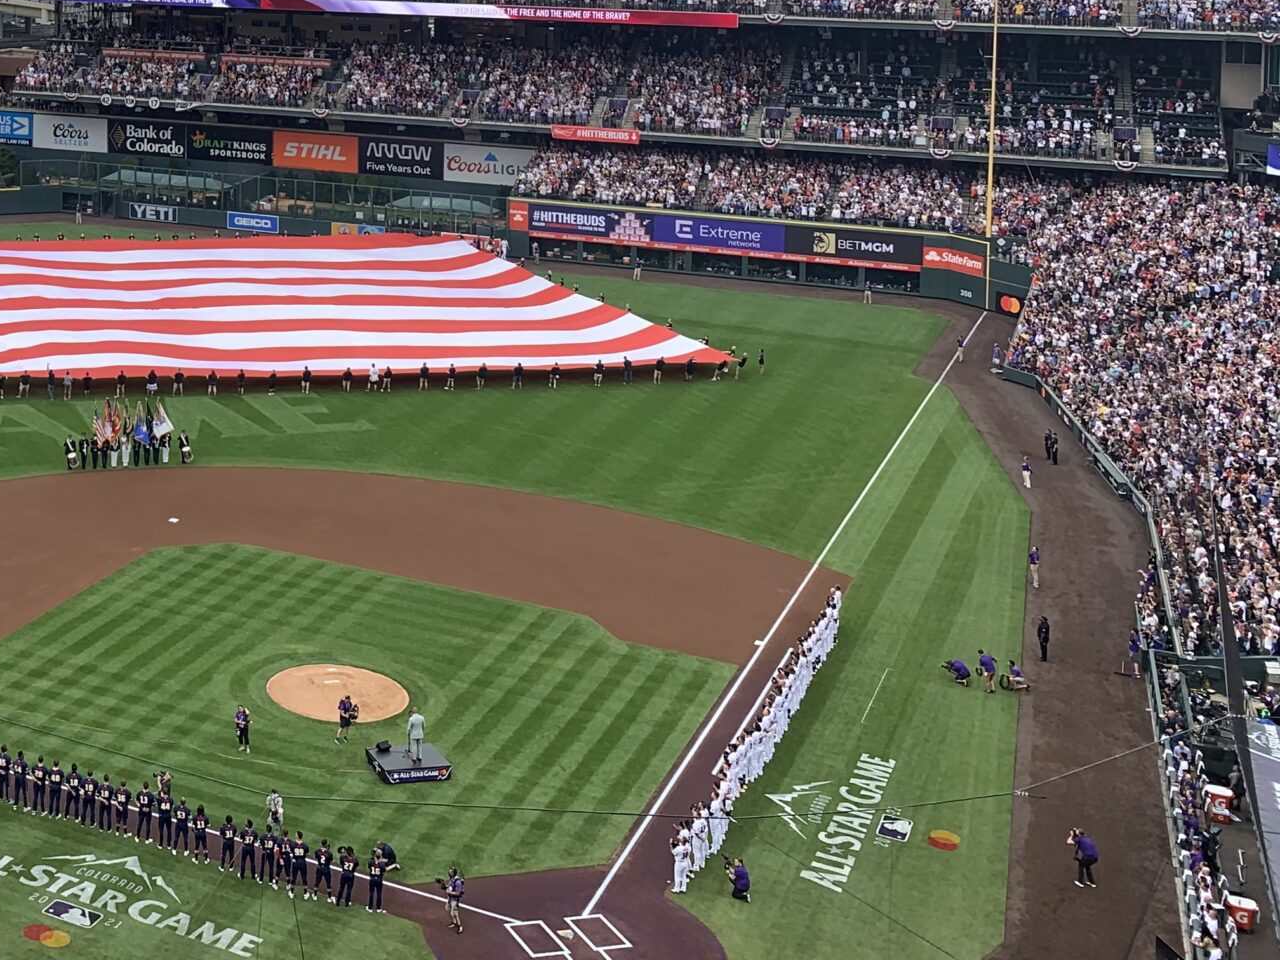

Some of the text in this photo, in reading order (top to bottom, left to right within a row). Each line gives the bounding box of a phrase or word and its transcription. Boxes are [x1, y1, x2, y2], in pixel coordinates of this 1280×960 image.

[507, 8, 518, 16] THE
[520, 9, 534, 17] FREE
[536, 9, 549, 17] AND
[551, 10, 561, 18] THE
[563, 10, 582, 18] HOME
[583, 11, 591, 19] OF
[593, 12, 604, 20] THE
[605, 12, 630, 21] BRAVE?
[52, 123, 89, 140] Coors
[126, 124, 173, 140] Bank of
[576, 129, 629, 140] #HITTHEBUDS
[54, 139, 89, 147] SELTZER
[126, 138, 184, 157] Colorado
[192, 139, 266, 151] DRAFTKINGS
[209, 149, 266, 160] SPORTSBOOK
[283, 142, 347, 161] STIHL
[366, 162, 431, 175] Five Years Out
[446, 155, 491, 174] Coors
[134, 204, 174, 221] YETI
[532, 210, 606, 227] #HITTHEBUDS
[234, 217, 272, 228] GEICO
[699, 224, 761, 241] Extreme
[728, 240, 761, 249] networks
[837, 239, 894, 254] BETMGM
[960, 289, 972, 298] 350
[839, 753, 896, 804] GAME
[160, 802, 170, 811] 44
[1214, 798, 1227, 809] G
[196, 820, 205, 829] 11
[244, 836, 253, 844] 37
[343, 861, 354, 870] 27
[76, 867, 143, 894] COLORADO
[28, 892, 49, 905] 20
[103, 917, 123, 929] 21
[1235, 911, 1249, 924] G
[128, 899, 263, 958] GAME
